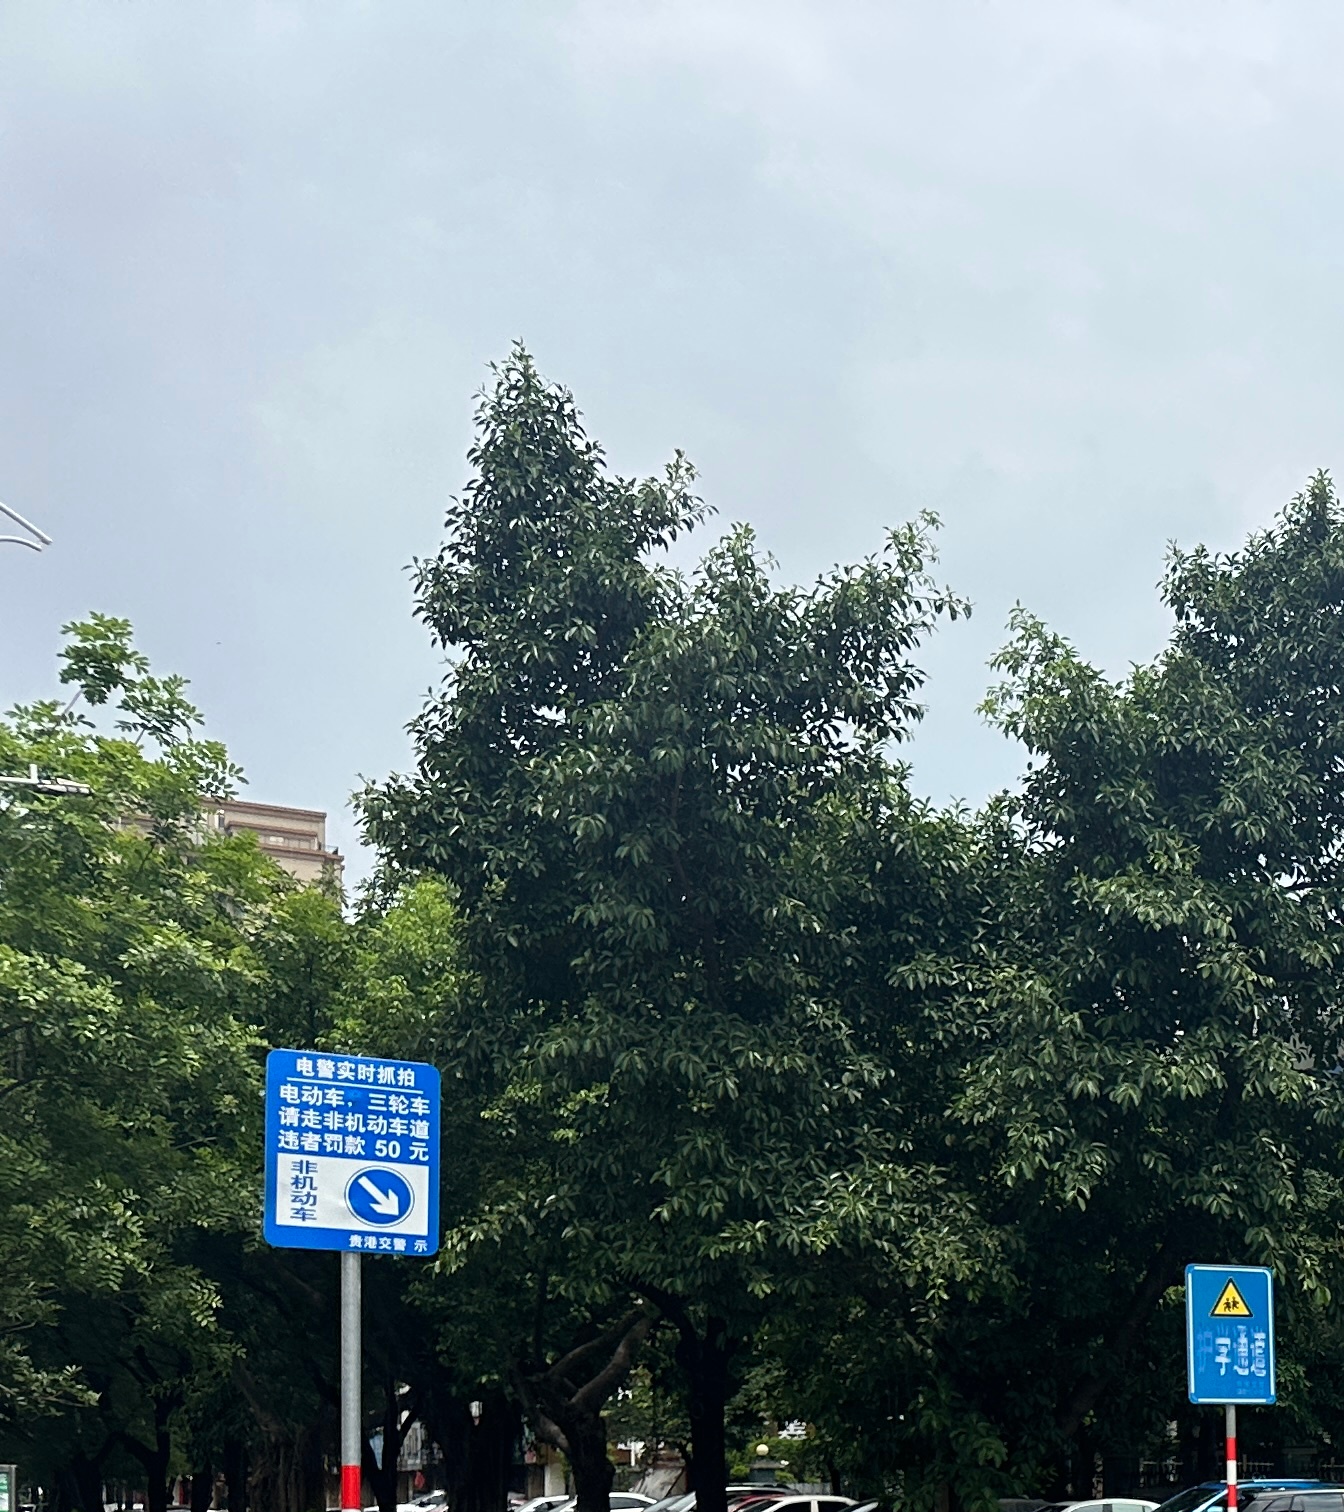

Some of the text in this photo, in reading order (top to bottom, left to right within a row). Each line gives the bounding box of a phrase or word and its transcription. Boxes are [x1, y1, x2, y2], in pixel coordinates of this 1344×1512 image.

[296, 1056, 415, 1087] 电警实时抓拍
[278, 1106, 430, 1139] 请走非机动车道
[278, 1129, 429, 1161] 违者罚款 50 元
[290, 1159, 318, 1222] 非机动车
